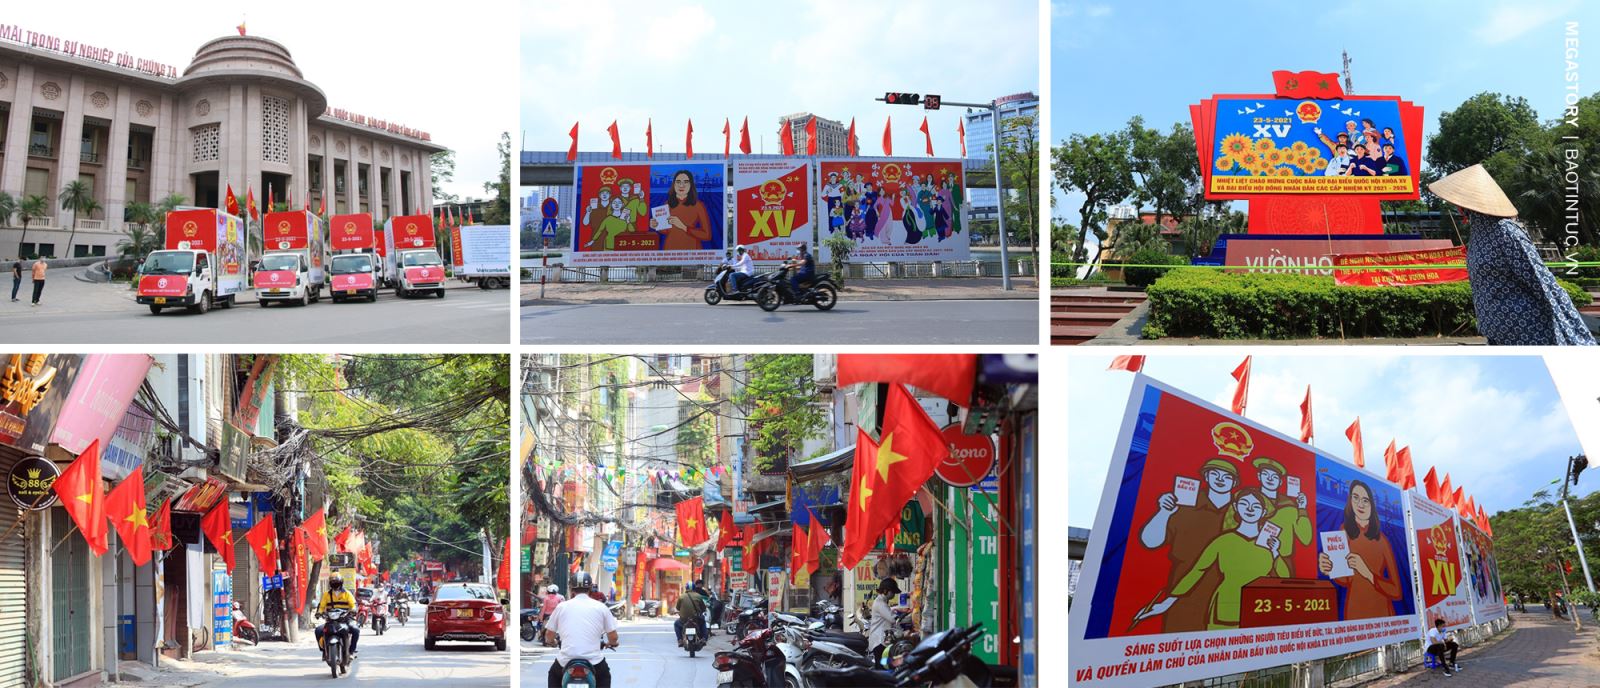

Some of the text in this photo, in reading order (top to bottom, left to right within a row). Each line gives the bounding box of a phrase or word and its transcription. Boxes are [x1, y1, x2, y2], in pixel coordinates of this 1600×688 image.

[27, 30, 60, 52] TRONG
[64, 39, 78, 57] SỰ
[80, 43, 114, 64] NGHIỆP
[116, 51, 134, 69] CỦA
[137, 56, 166, 77] CHÚNG
[167, 64, 178, 79] TA
[1253, 124, 1292, 138] XV
[749, 209, 795, 237] XV
[1245, 248, 1333, 276] VƯỜN HO
[28, 479, 40, 488] 88
[1427, 558, 1456, 596] XV
[1254, 599, 1272, 613] 23
[1284, 599, 1293, 612] 5
[1304, 599, 1330, 611] 2021
[1124, 642, 1155, 657] SÁNG
[1158, 638, 1183, 653] SUỐT
[1185, 638, 1202, 651] LỰA
[1204, 638, 1226, 649] CHỌN
[1228, 634, 1254, 645] NHỮNG
[1256, 631, 1276, 642] NGƯỜI
[1277, 630, 1290, 640] TIÊU
[1291, 628, 1303, 639] BIỂU
[1076, 666, 1093, 682] VÀ
[1096, 659, 1137, 680] QUYỀN
[1140, 658, 1162, 673] LÀM
[1166, 653, 1184, 668] CHỦ
[1188, 651, 1205, 666] CỦA
[1208, 650, 1230, 664] NHÂN
[1232, 648, 1248, 660] DÂN
[1250, 645, 1264, 658] BẦU
[1266, 644, 1278, 655] VÀO
[1280, 641, 1296, 654] QUỐC
